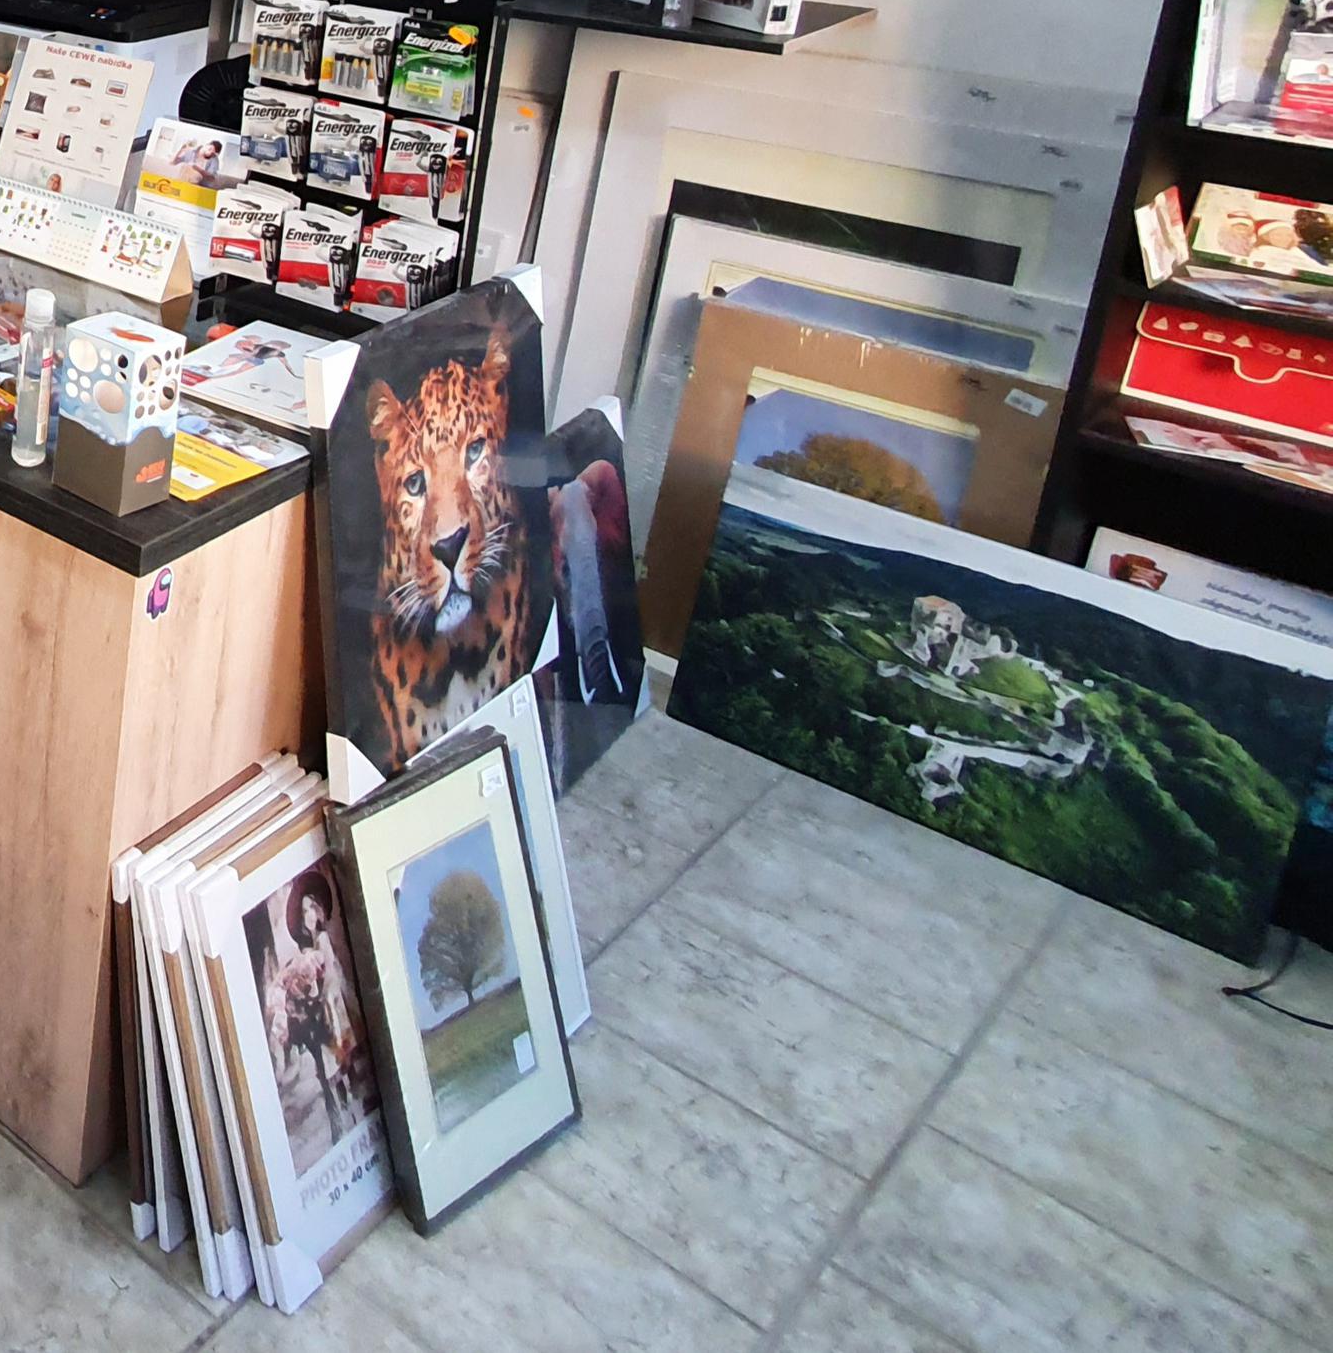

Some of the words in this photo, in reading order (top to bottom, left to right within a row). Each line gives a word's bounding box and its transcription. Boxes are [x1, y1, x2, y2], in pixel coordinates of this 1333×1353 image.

[256, 10, 315, 26] Energizer
[327, 23, 392, 39] Energizer
[403, 32, 465, 53] Energizer
[68, 48, 97, 63] CEWE
[244, 104, 301, 120] Energizer
[314, 120, 377, 137] Energizer
[389, 137, 448, 156] Energizer
[216, 207, 280, 224] Energizer
[285, 228, 348, 246] Energizer
[361, 245, 426, 264] Energizer
[300, 1153, 349, 1209] PHOTO
